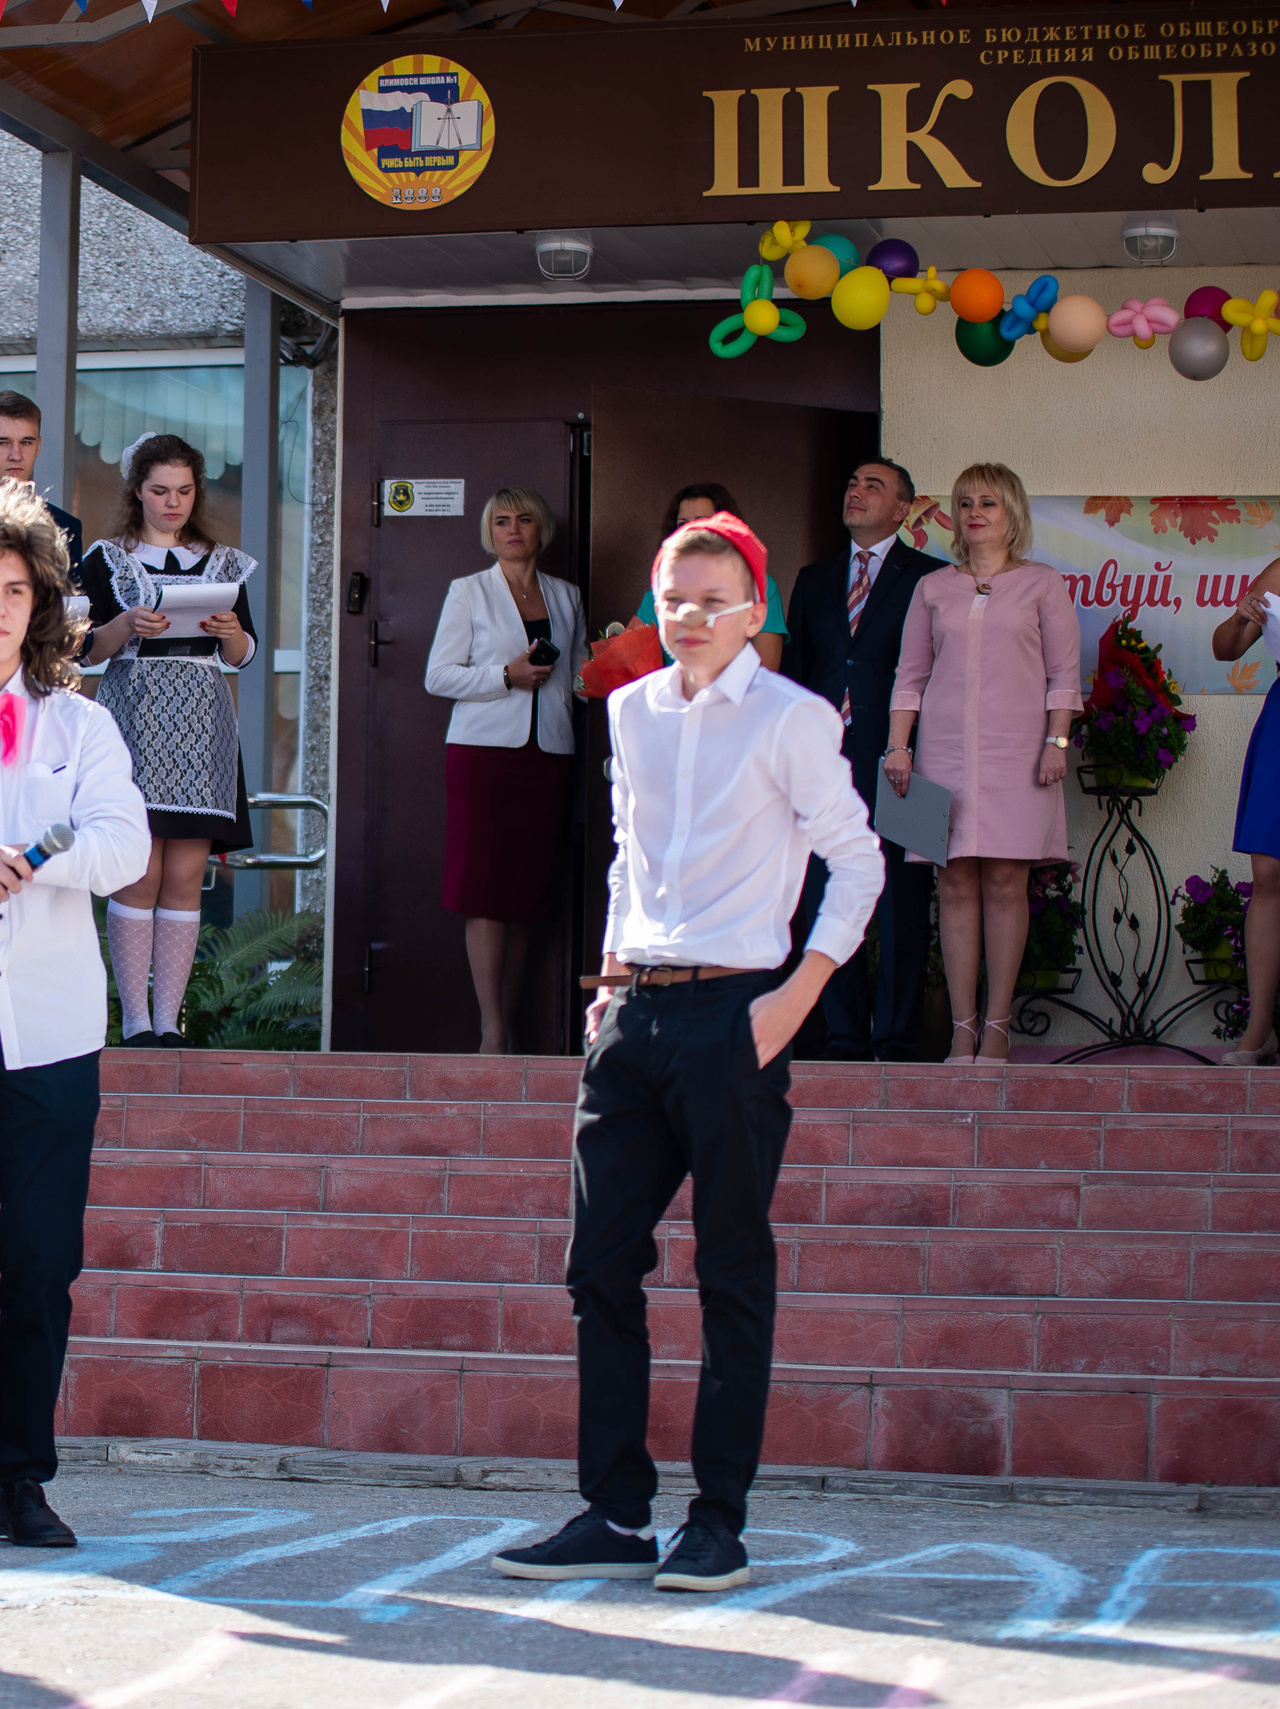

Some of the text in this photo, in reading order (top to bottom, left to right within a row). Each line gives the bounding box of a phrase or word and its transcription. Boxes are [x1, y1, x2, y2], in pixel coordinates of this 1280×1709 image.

[744, 29, 971, 52] МУНИЦИПАЛЬНОЕ
[985, 23, 1147, 44] БЮДЖЕТНОЕ
[979, 41, 1277, 66] СРЕДНЯЯ ОБЩЕОБРАЗО
[379, 77, 419, 87] КЛИМОВСК
[419, 76, 445, 85] ШКОЛА
[702, 71, 1280, 197] ШКОЛ
[381, 155, 455, 168] УЧИСЬ БЫТЬ ПЕРВЫМ
[391, 187, 443, 204] 1888
